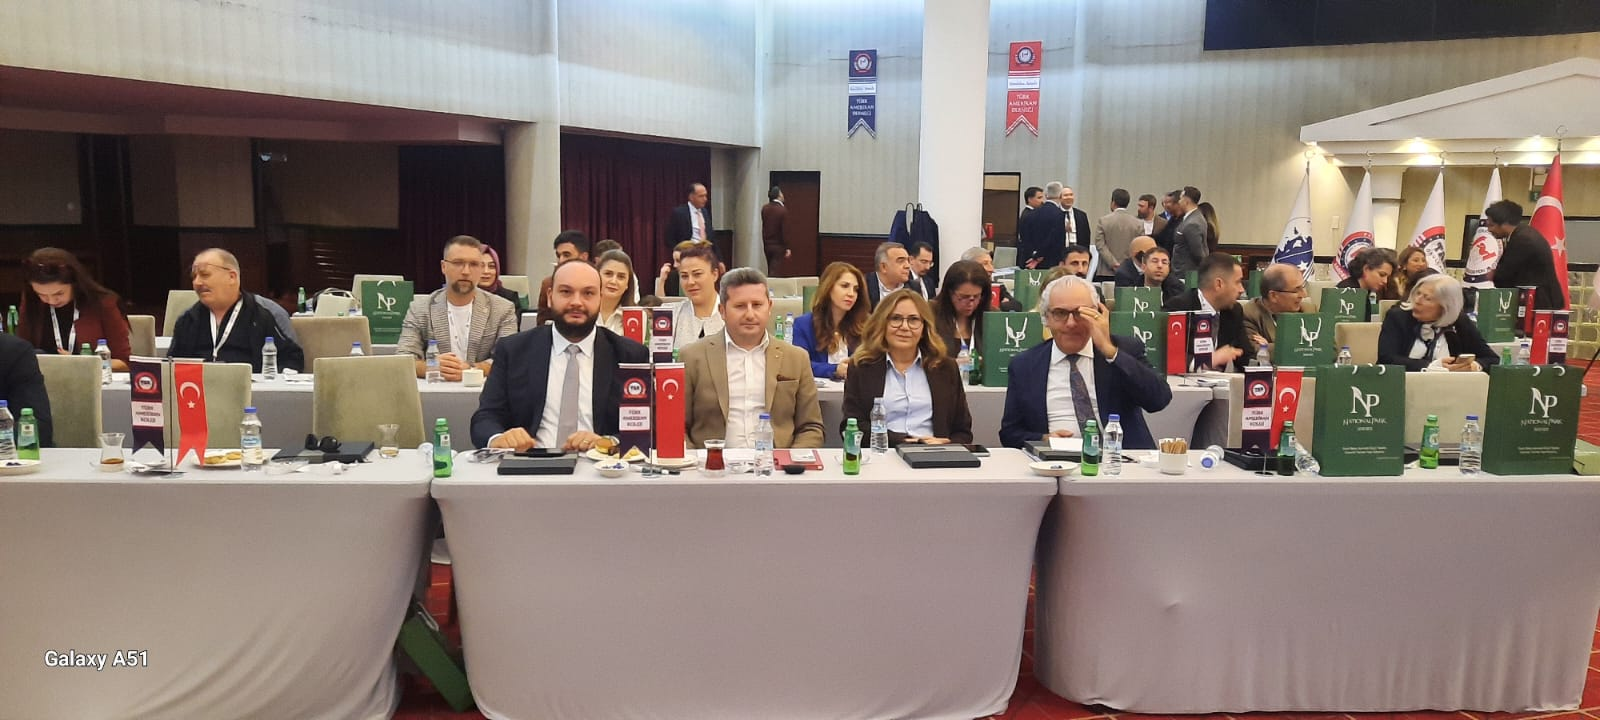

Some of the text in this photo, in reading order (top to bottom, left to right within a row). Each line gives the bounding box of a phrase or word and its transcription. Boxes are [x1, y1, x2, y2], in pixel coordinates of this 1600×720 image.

[377, 292, 397, 311] NP
[1350, 386, 1380, 417] NP
[1529, 387, 1558, 418] NP
